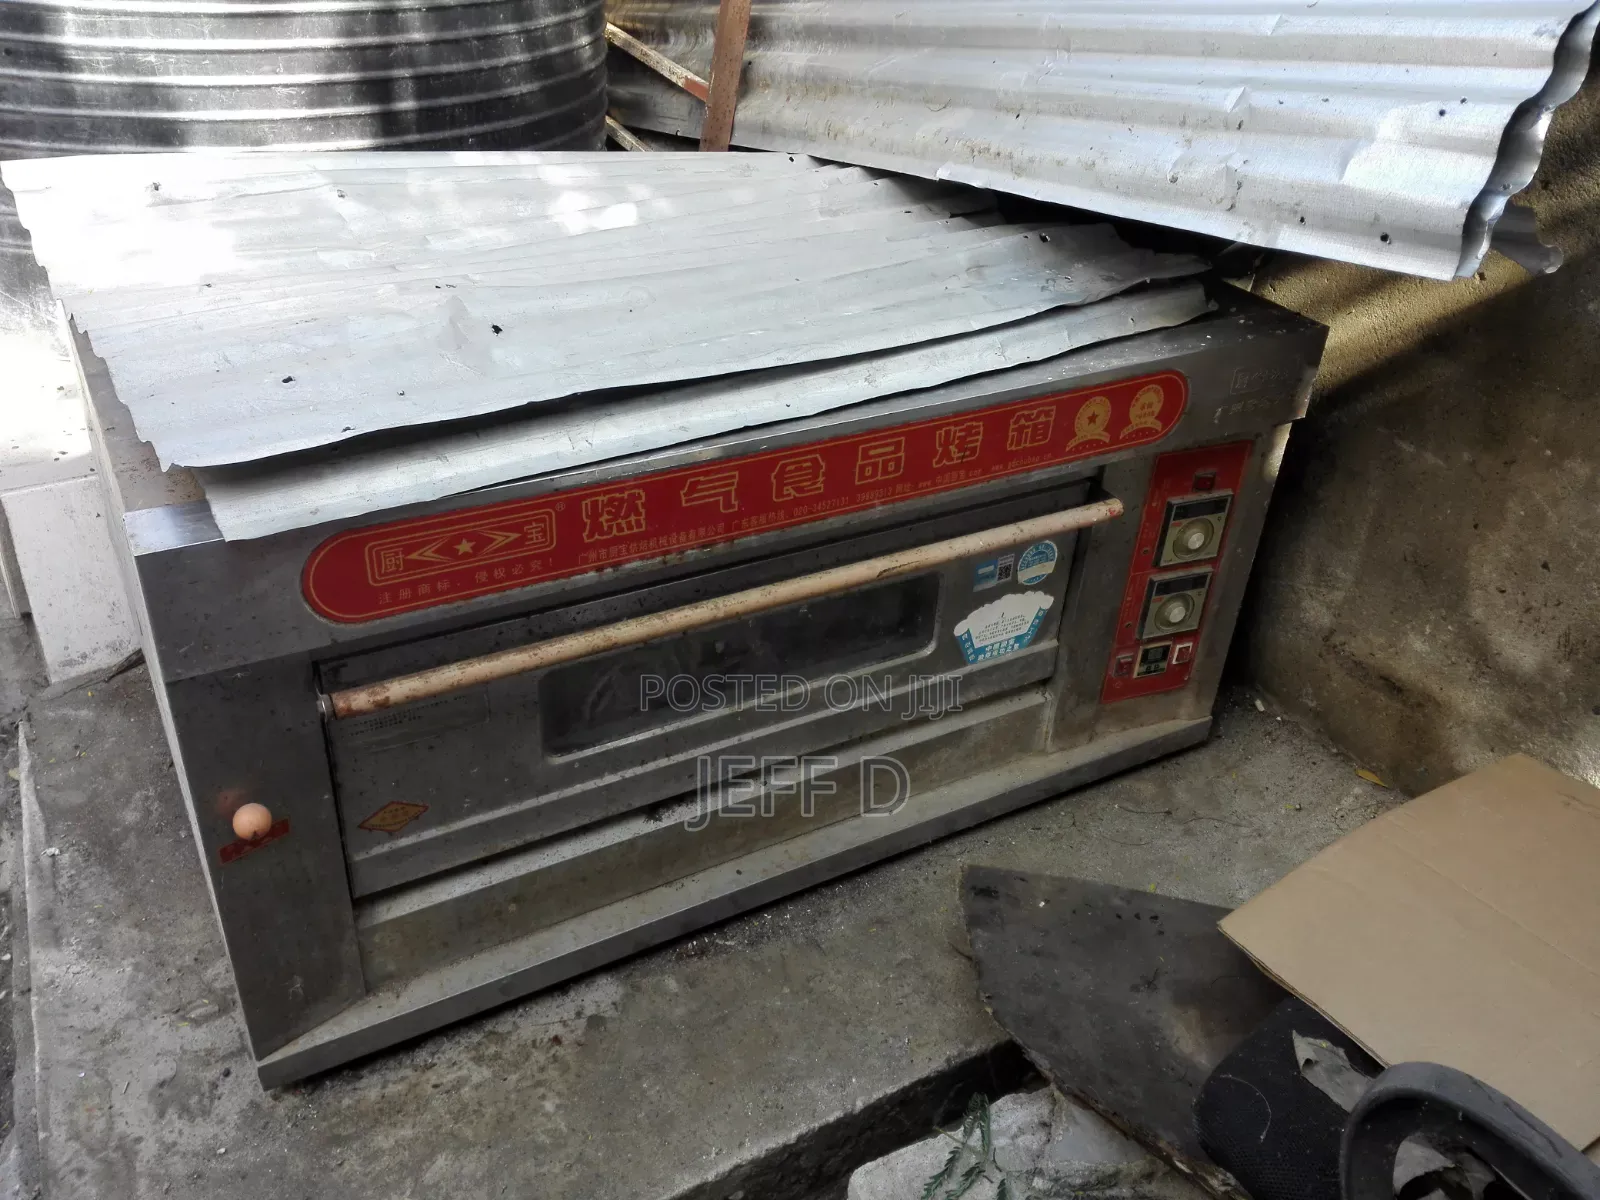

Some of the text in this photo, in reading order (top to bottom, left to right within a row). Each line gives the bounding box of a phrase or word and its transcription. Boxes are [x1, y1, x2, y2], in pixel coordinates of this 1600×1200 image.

[582, 406, 1056, 543] 燃气食品烤箱
[380, 522, 546, 574] 厨 宝
